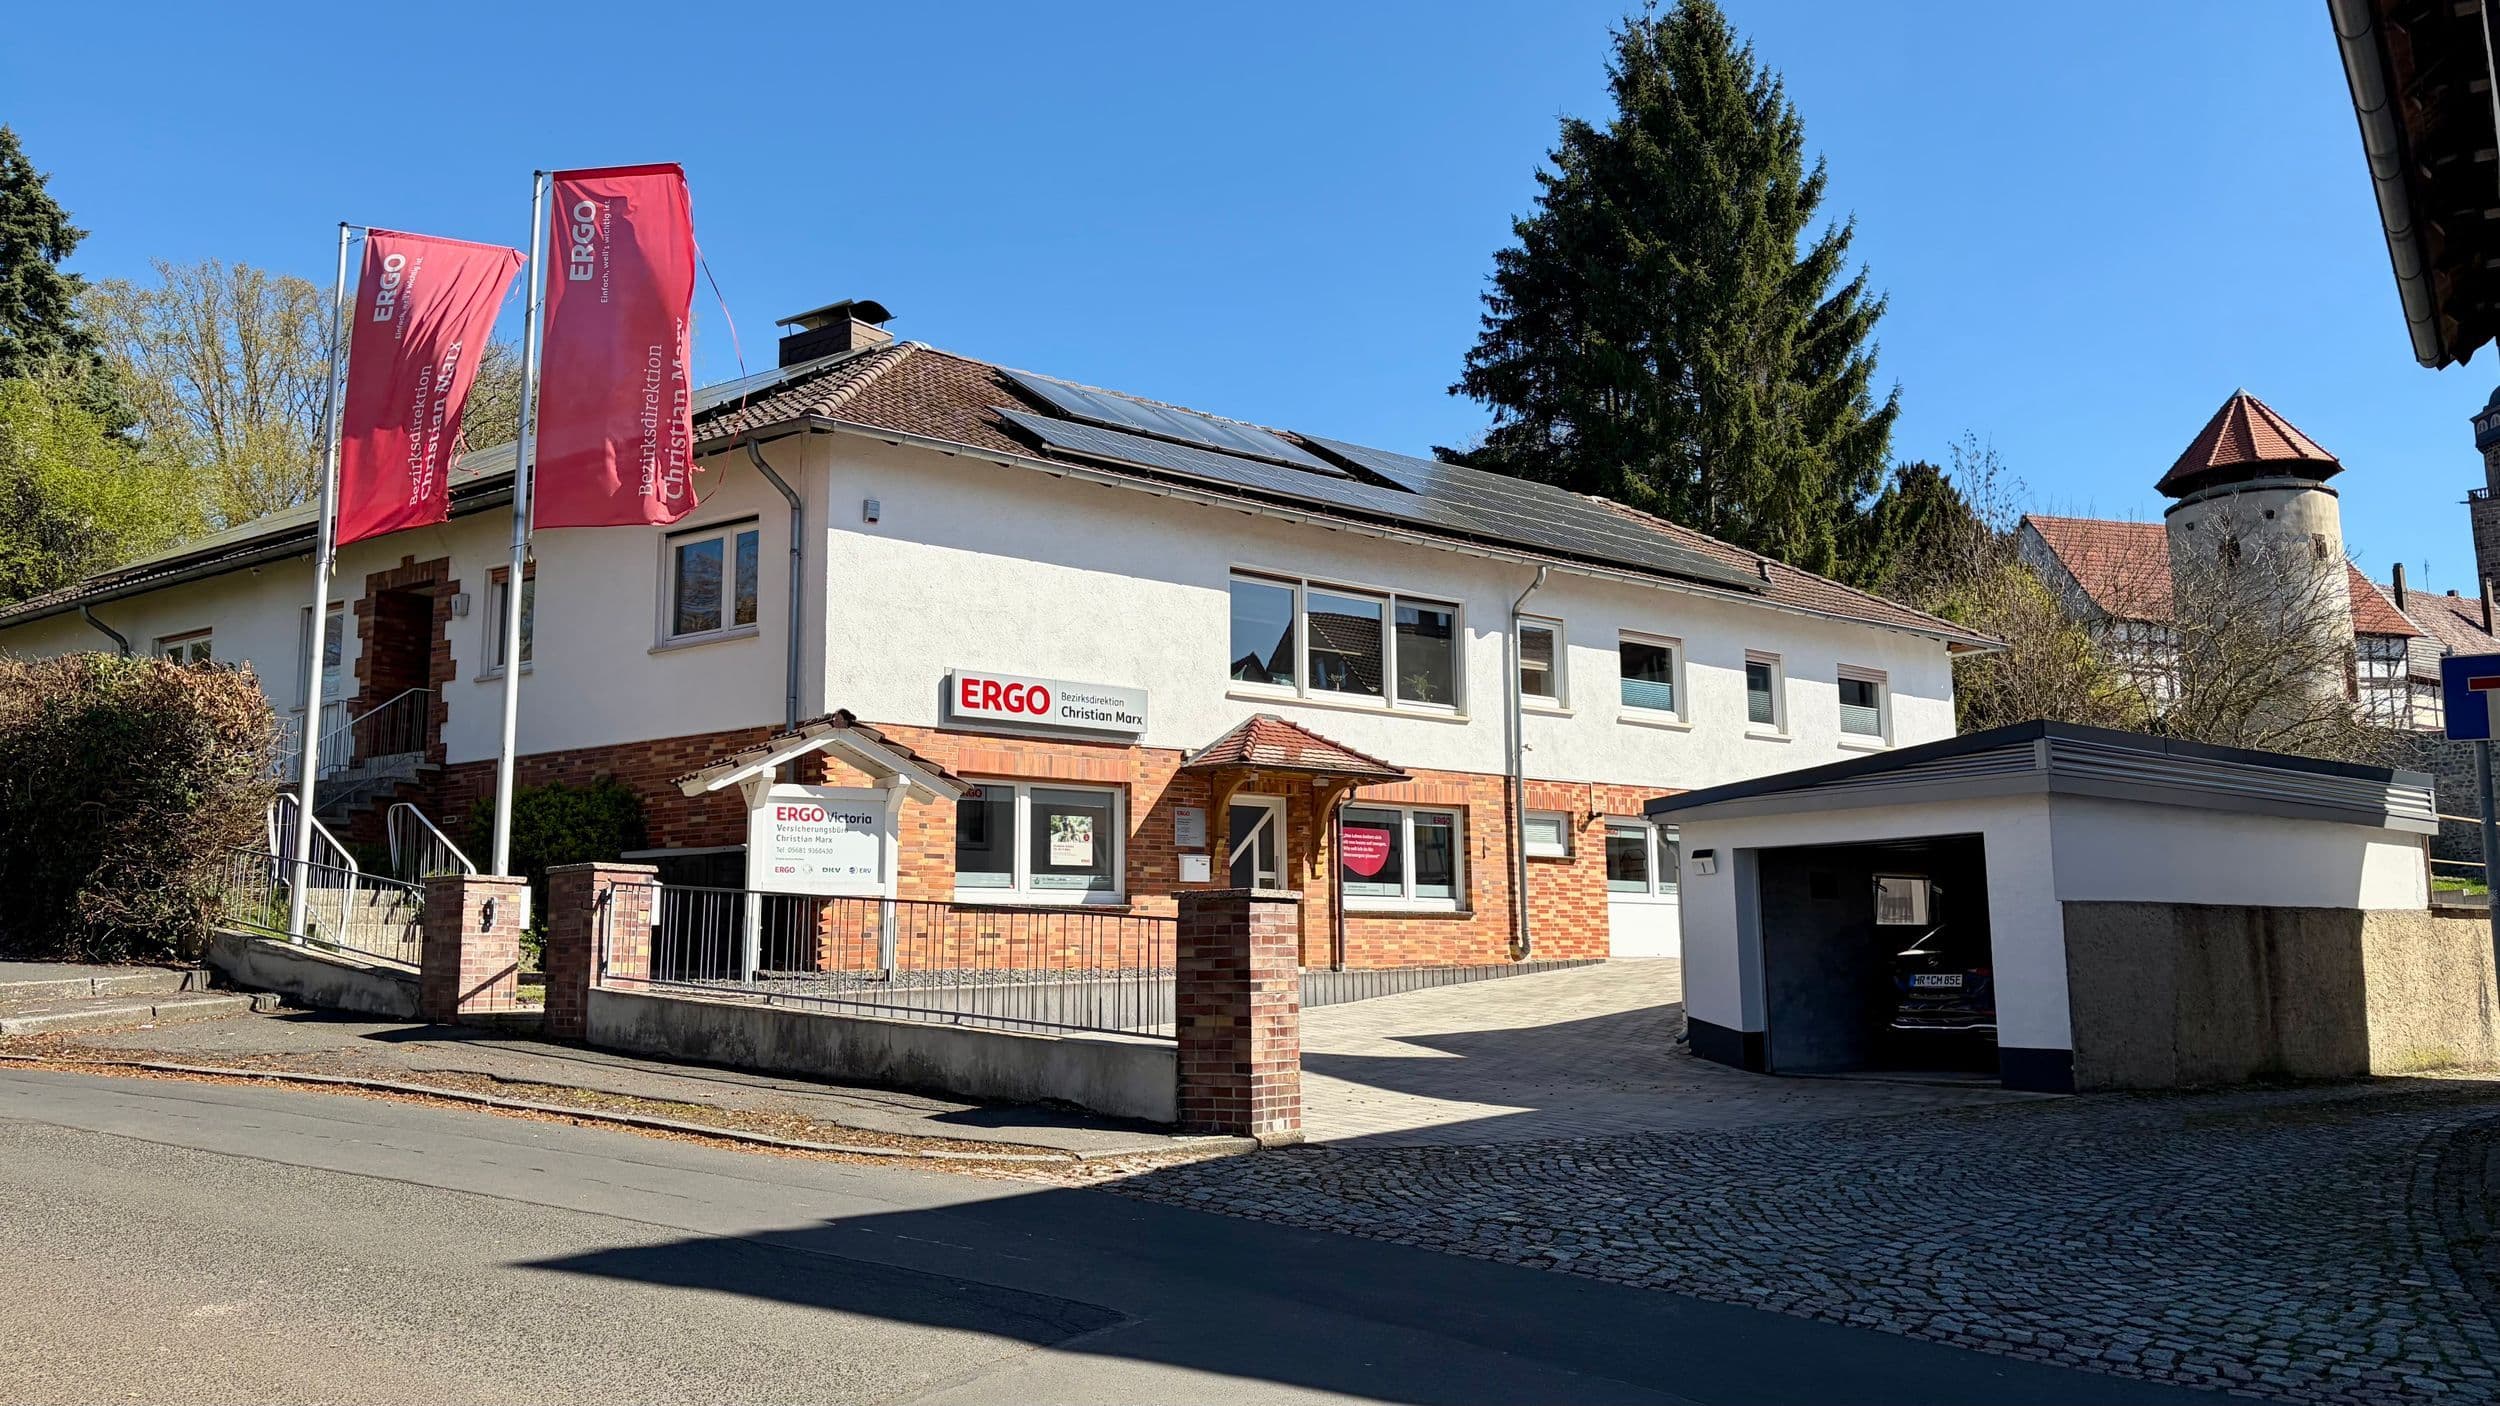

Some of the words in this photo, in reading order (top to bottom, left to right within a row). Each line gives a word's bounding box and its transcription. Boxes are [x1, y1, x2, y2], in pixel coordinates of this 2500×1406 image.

[569, 200, 597, 281] ERGO
[602, 213, 612, 244] wichtig
[373, 253, 406, 322] ERGO
[600, 271, 610, 304] Einfach,
[408, 365, 433, 507] Bezirksdirektion
[421, 397, 446, 502] Christian
[434, 339, 464, 393] Marx
[638, 344, 662, 497] Bezirksdirektion
[663, 389, 686, 500] Christian
[961, 678, 1051, 716] ERGO
[1061, 692, 1125, 708] Bezirksdirektion
[1061, 705, 1113, 722] Christian
[1115, 712, 1143, 725] Marx
[776, 806, 824, 822] ERGO
[776, 823, 849, 835] Versicherungsbüro
[826, 811, 872, 824] Victoria
[776, 834, 813, 843] Christian
[815, 835, 833, 844] Marx
[775, 866, 796, 874] ERGO
[1914, 976, 1925, 985] HR
[1930, 976, 1943, 985] CM
